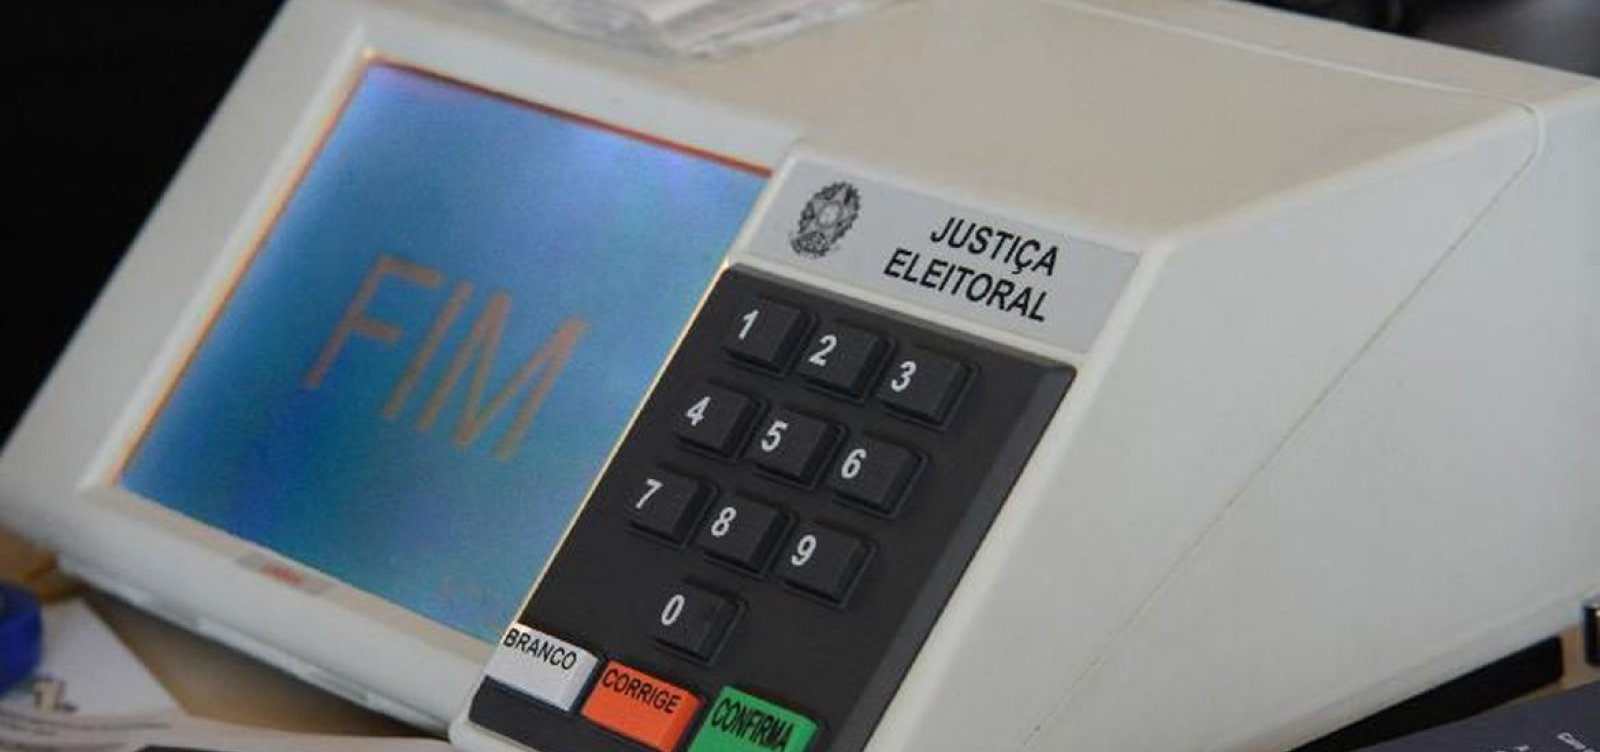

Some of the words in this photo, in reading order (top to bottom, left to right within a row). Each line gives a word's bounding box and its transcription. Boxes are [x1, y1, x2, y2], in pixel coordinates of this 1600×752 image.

[931, 217, 1059, 276] JUSTIÇA
[884, 248, 1047, 322] ELEITORAL
[304, 255, 586, 458] FIM
[740, 310, 759, 339] 1
[810, 335, 837, 365] 2
[891, 361, 916, 391] 3
[687, 397, 710, 425] 4
[762, 421, 787, 451] 5
[842, 449, 866, 478] 6
[636, 480, 662, 508] 7
[712, 507, 736, 536] 8
[792, 535, 816, 565] 9
[662, 595, 684, 625] 0
[503, 627, 578, 671] BRANCO
[602, 668, 682, 714] CORRIGE
[711, 697, 794, 752] CONFIRMA
